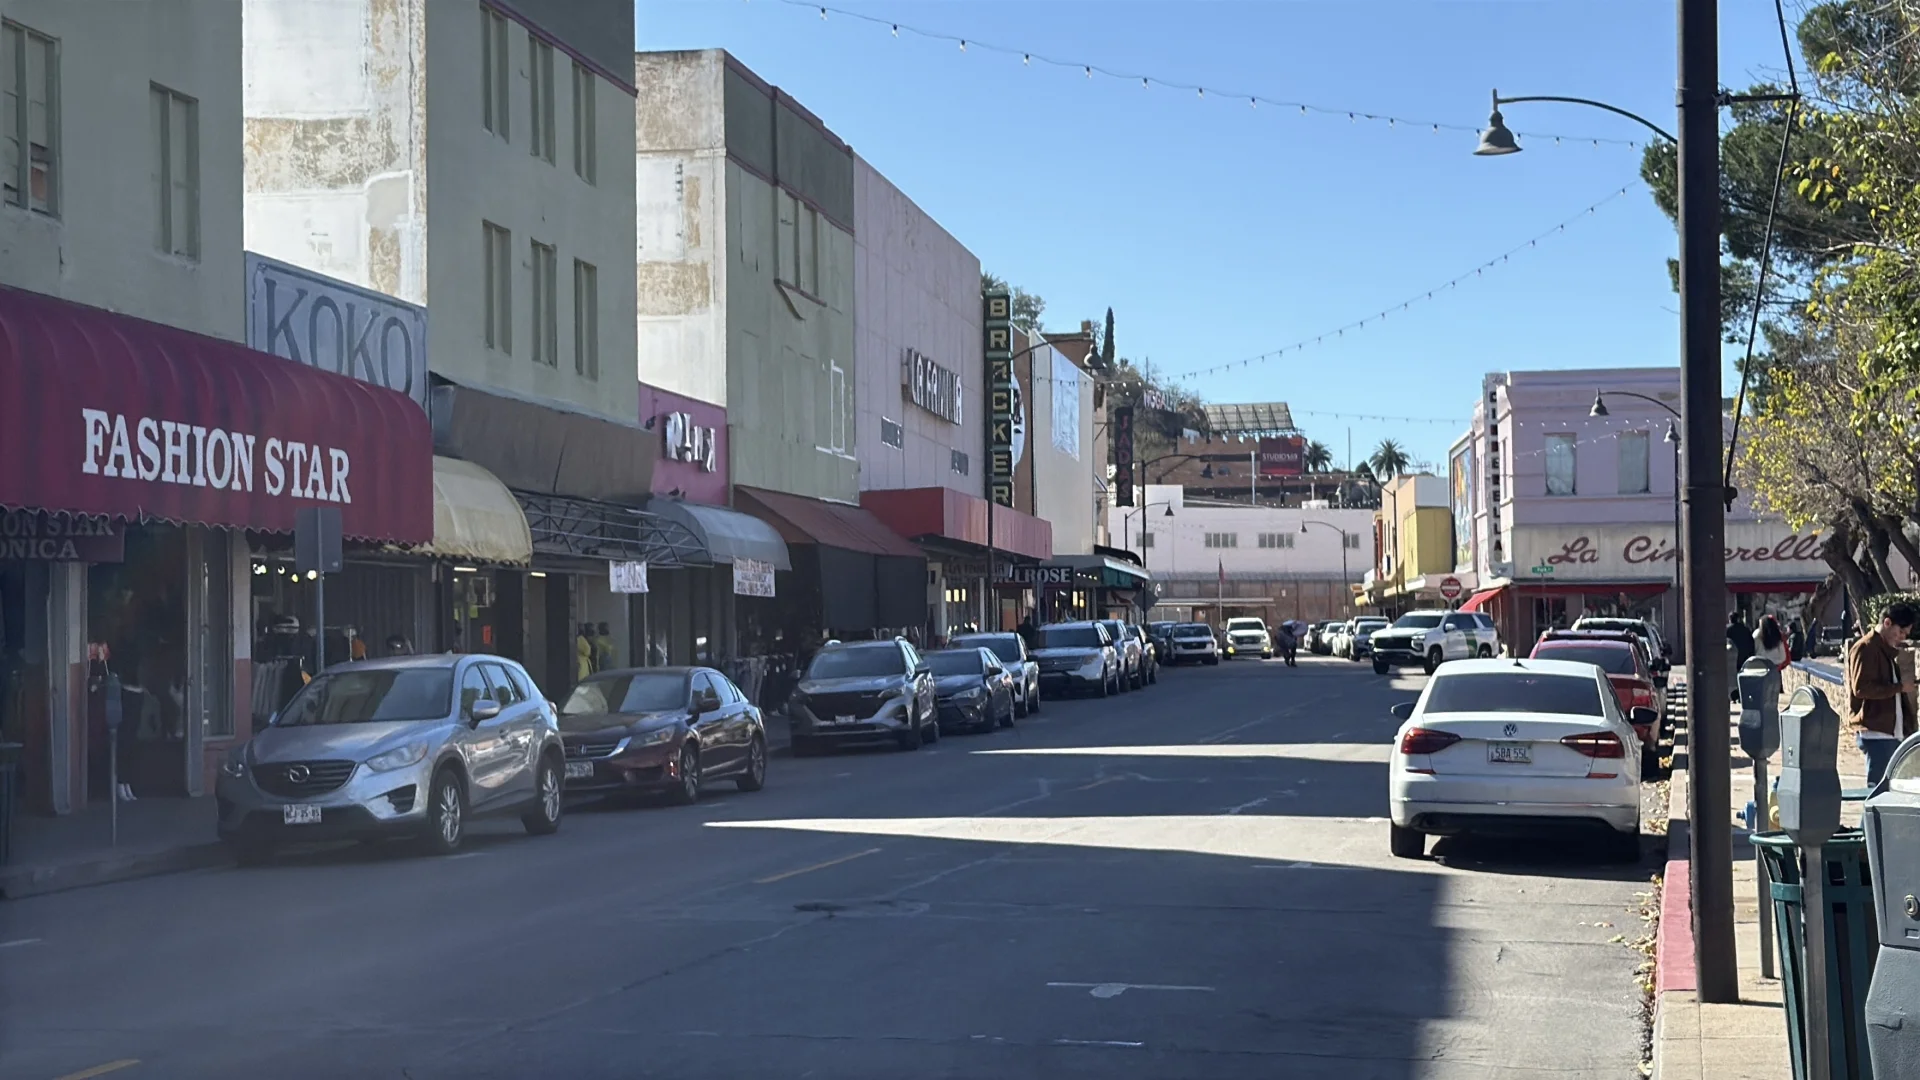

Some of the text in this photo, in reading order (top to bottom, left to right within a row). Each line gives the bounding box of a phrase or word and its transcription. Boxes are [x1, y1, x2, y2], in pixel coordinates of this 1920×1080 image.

[264, 278, 412, 396] KOKO
[82, 408, 351, 503] FASHION STAR
[1549, 536, 1599, 564] La
